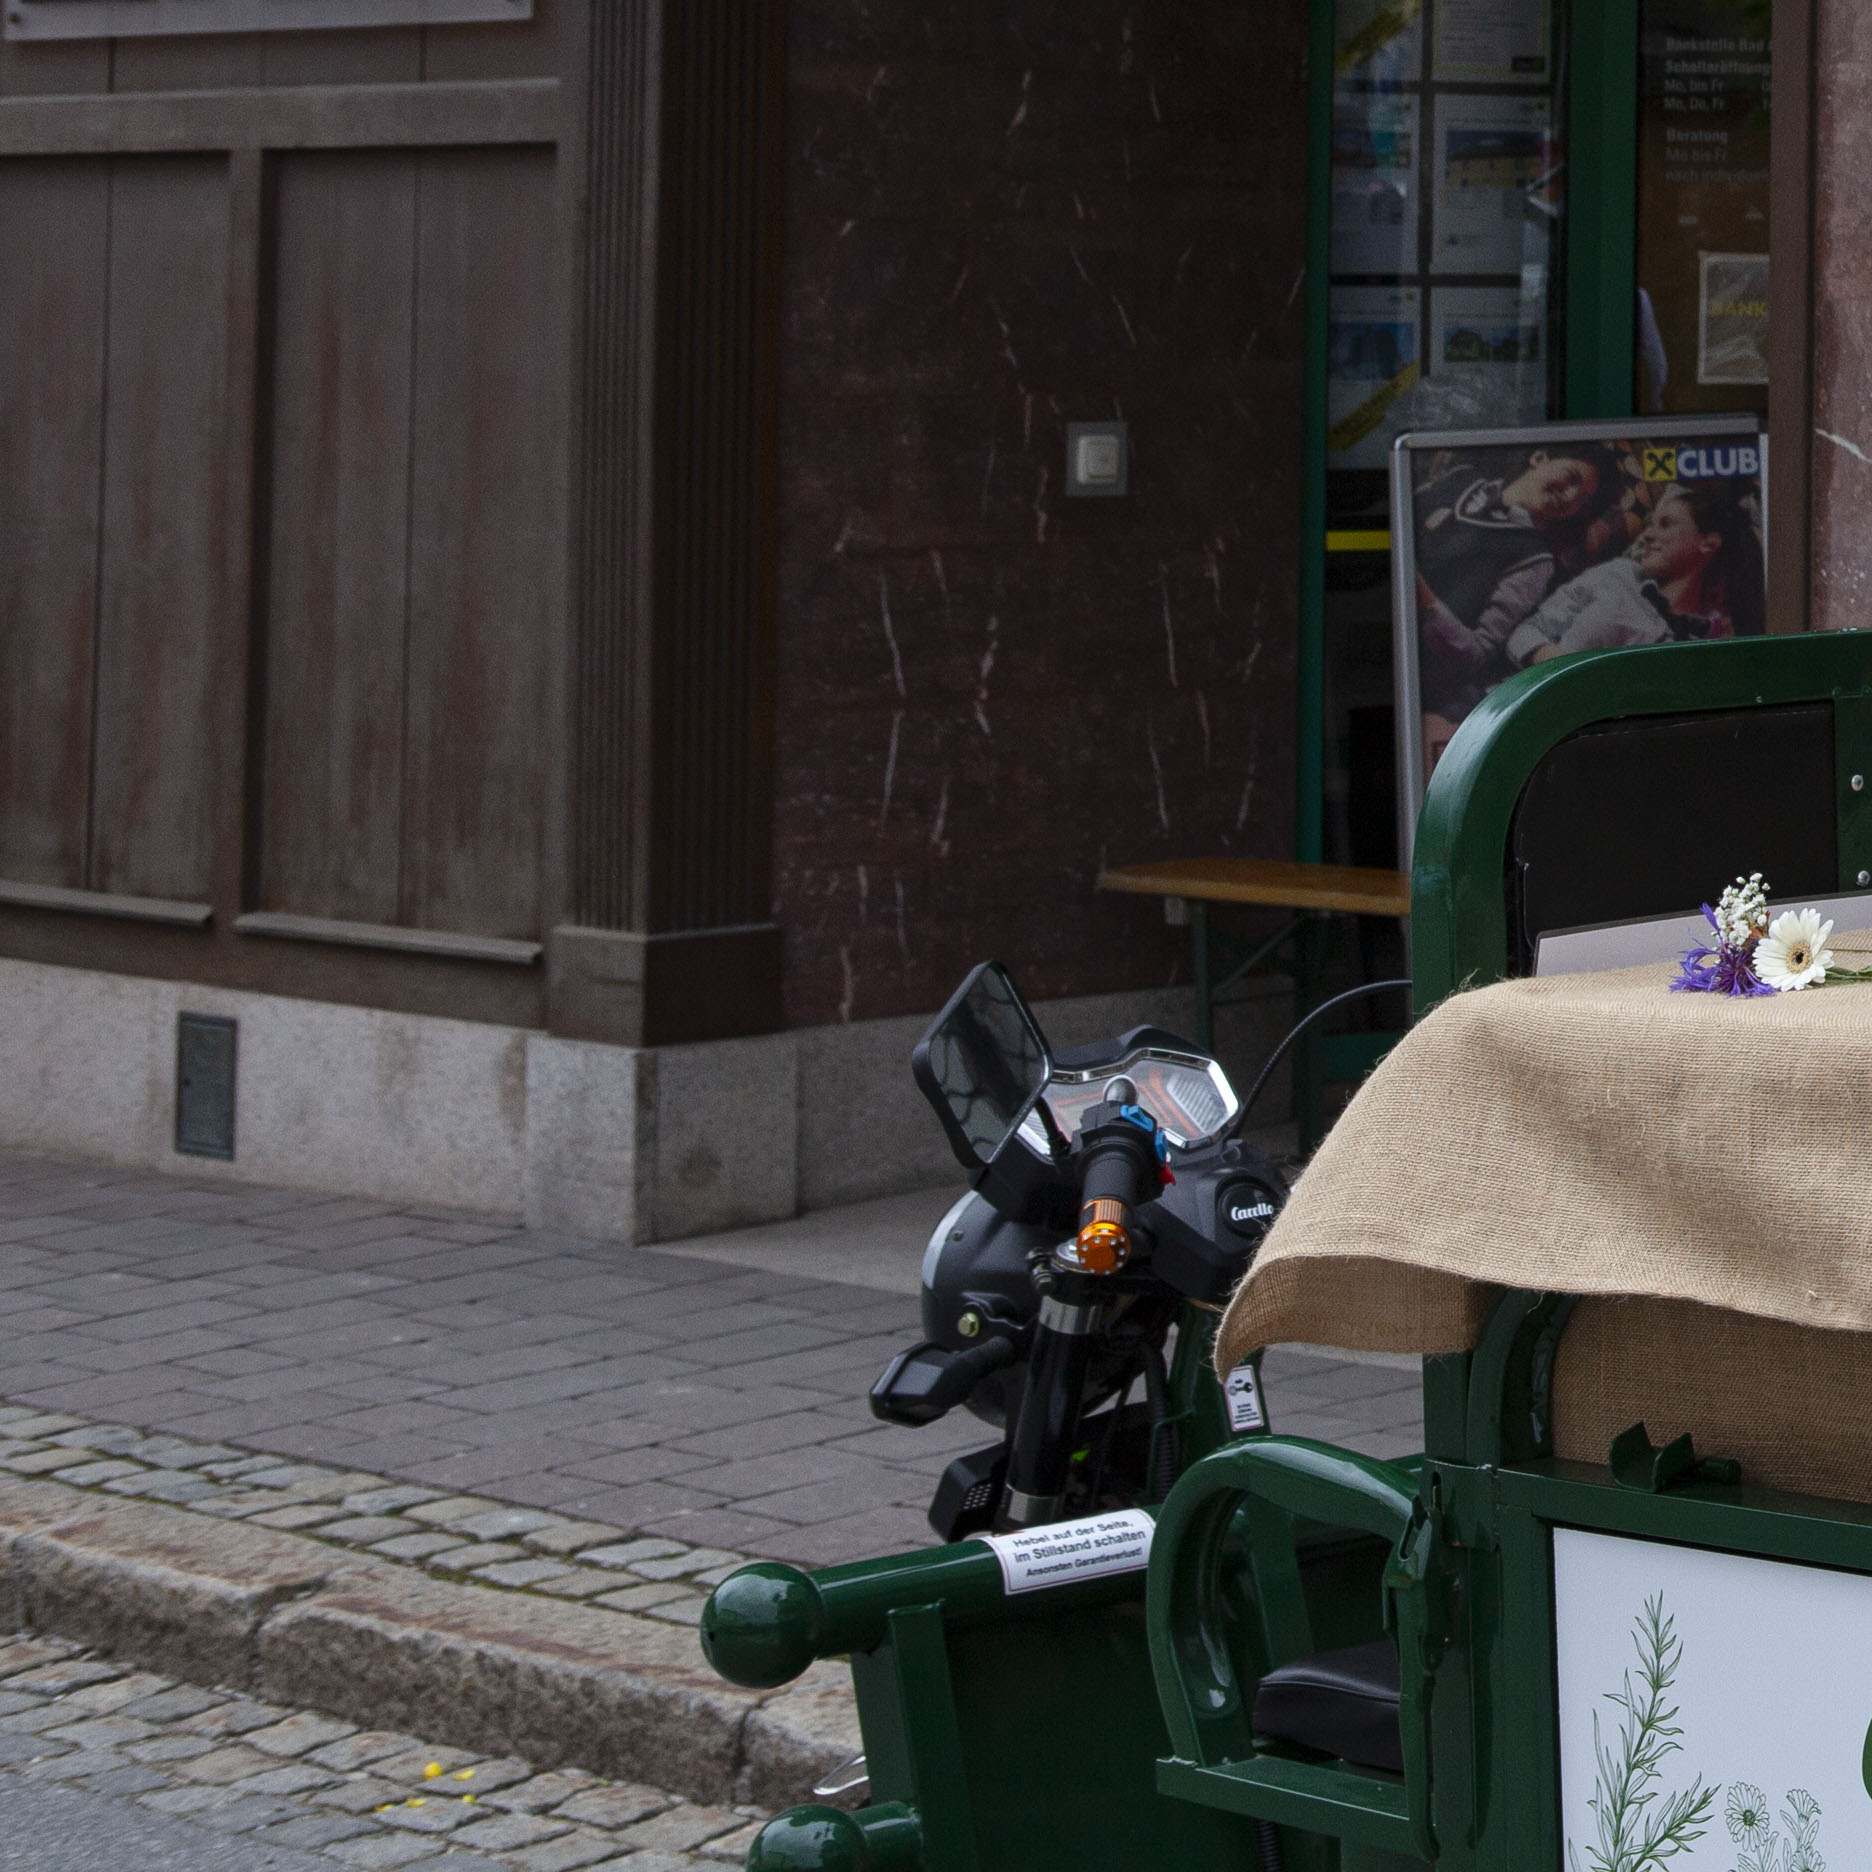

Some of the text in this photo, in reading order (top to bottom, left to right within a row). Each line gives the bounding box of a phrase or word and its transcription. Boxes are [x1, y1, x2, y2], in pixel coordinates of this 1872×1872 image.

[1677, 447, 1758, 477] CLUB
[1013, 1535, 1050, 1547] Hebel
[1053, 1529, 1072, 1541] auf
[1074, 1526, 1095, 1536] der
[1032, 1540, 1092, 1560] Stillstand
[1095, 1530, 1146, 1548] schalten
[1026, 1562, 1073, 1577] Ansonsten
